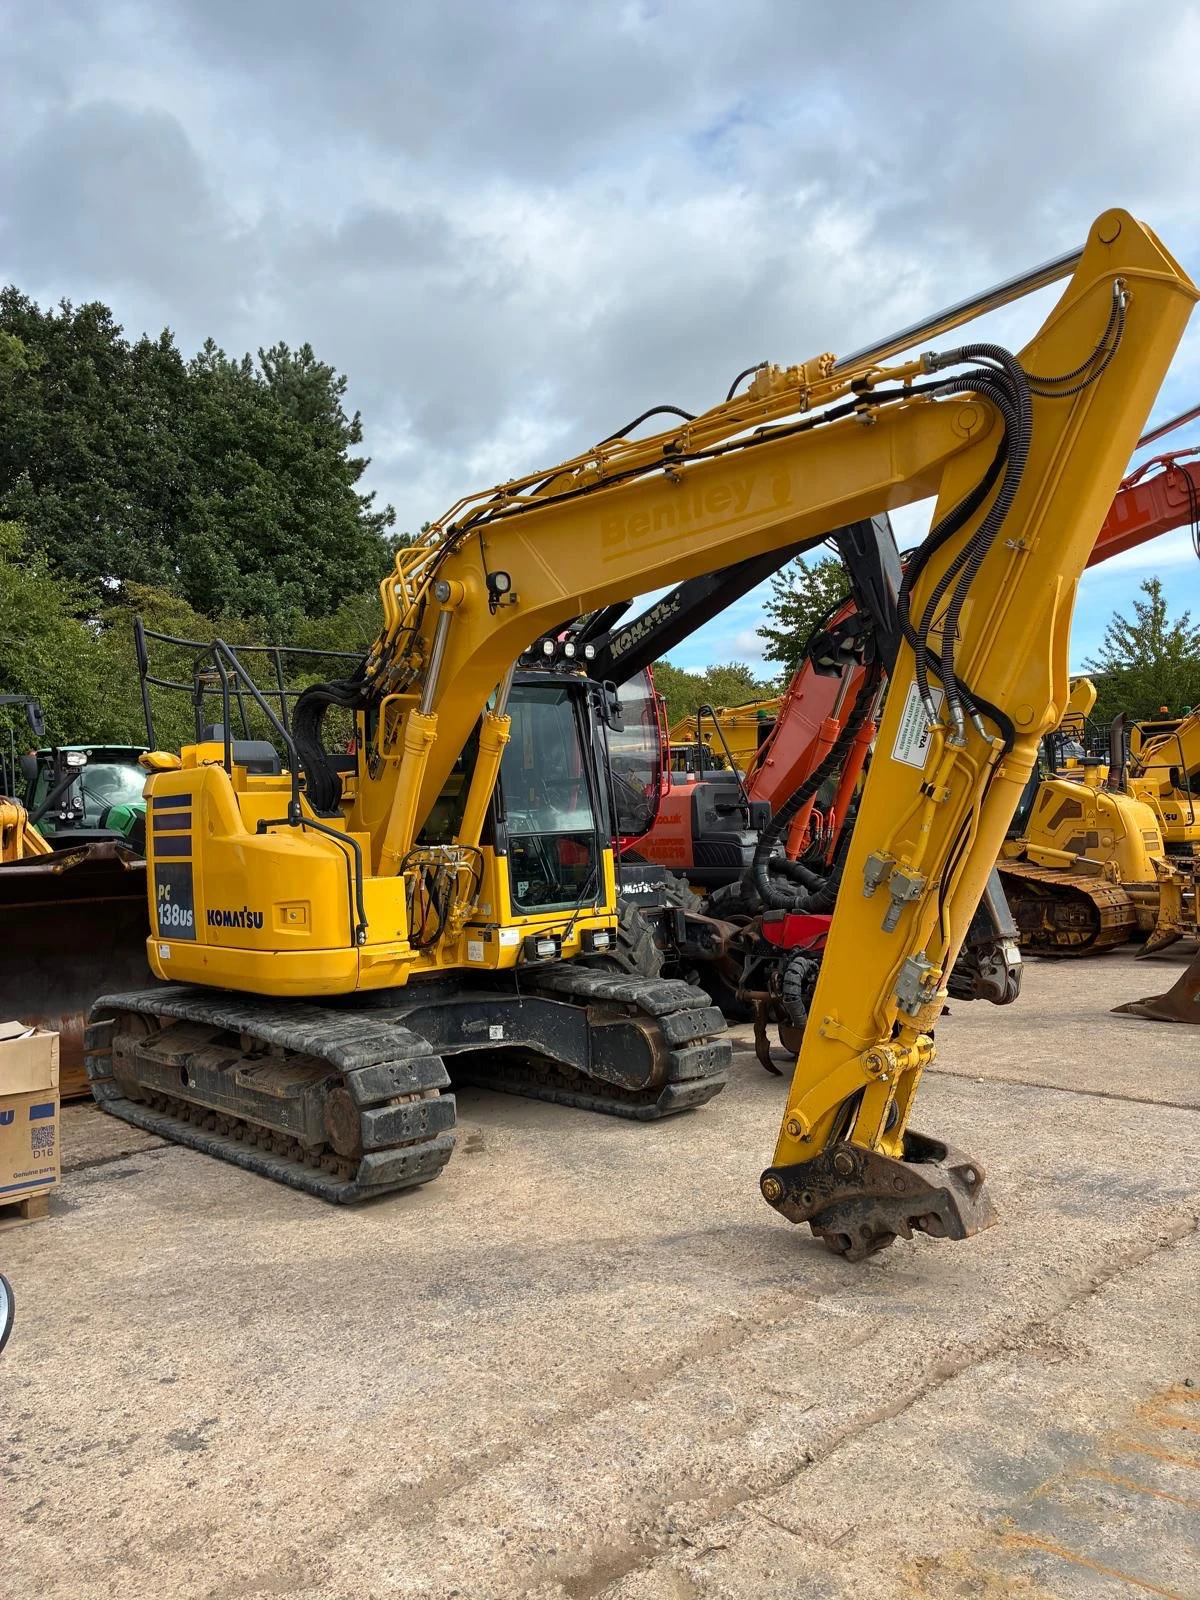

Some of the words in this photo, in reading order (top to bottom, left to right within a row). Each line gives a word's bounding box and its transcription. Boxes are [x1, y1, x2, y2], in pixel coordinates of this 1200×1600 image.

[602, 474, 754, 547] Bentley
[158, 884, 171, 901] PC
[207, 906, 264, 929] KOMATSU
[33, 1148, 53, 1159] D16
[13, 1168, 39, 1179] Genuine
[39, 1165, 56, 1175] parts
